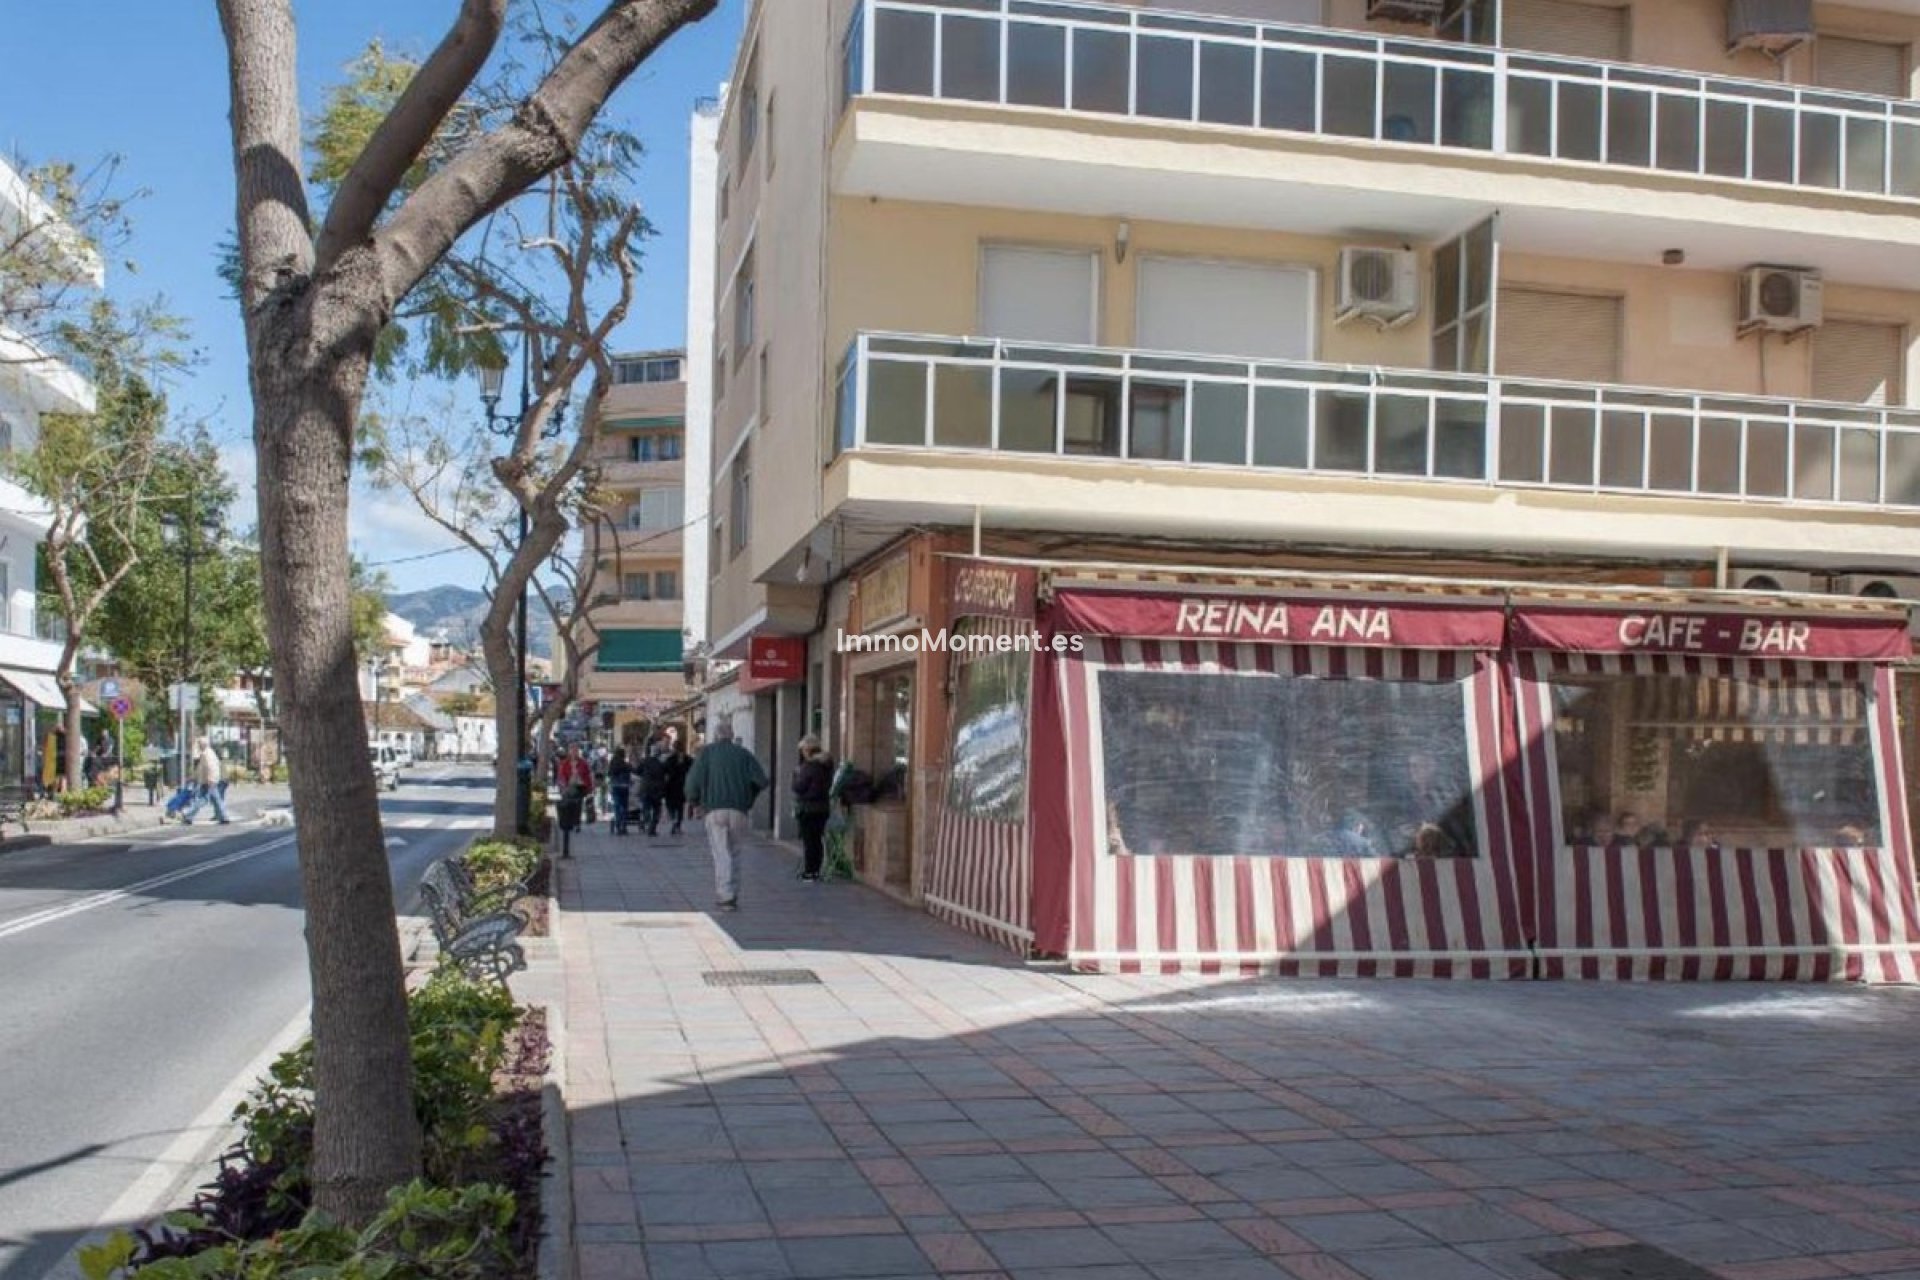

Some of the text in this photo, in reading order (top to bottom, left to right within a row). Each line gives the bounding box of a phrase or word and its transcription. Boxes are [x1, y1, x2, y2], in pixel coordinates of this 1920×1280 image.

[1175, 599, 1393, 639] REINA ANA
[1619, 615, 1706, 649] CAFE
[1739, 619, 1811, 652] BAR
